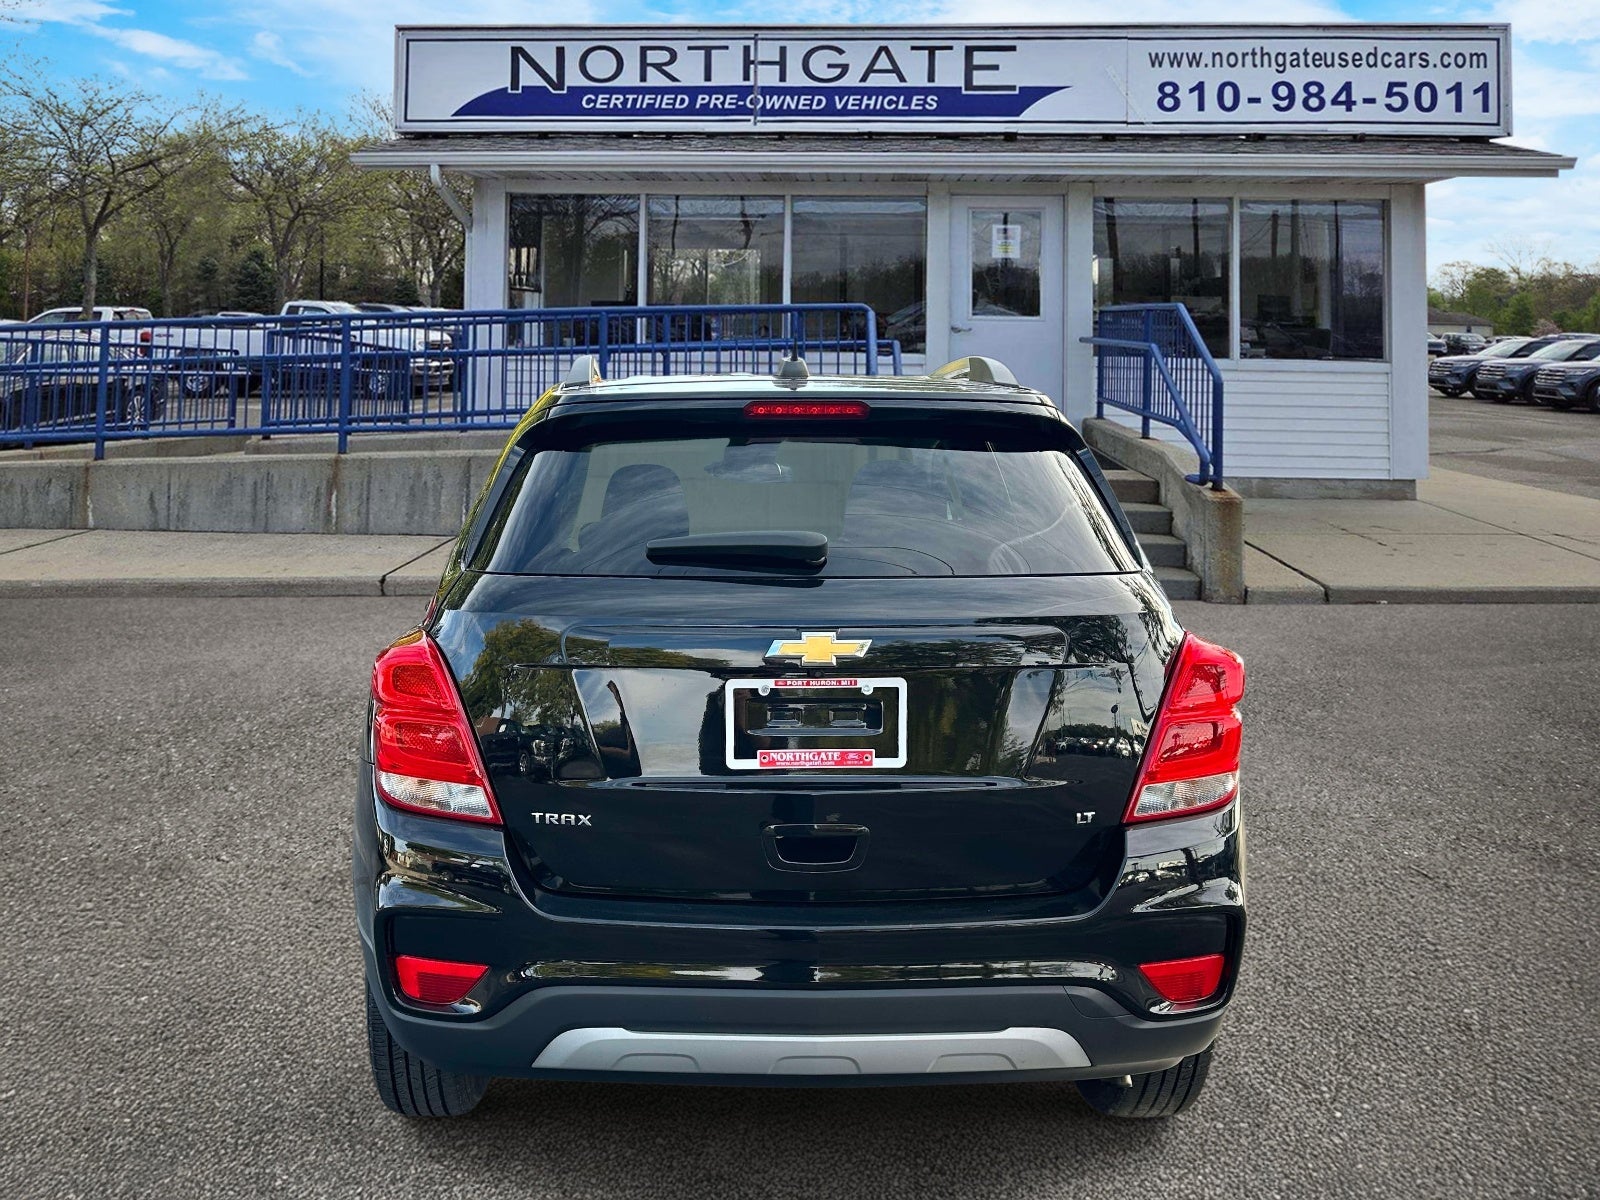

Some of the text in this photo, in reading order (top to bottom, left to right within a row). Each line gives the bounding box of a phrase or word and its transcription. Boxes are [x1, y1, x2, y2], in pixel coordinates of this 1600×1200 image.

[509, 44, 1017, 93] NORTHGATE
[1149, 46, 1488, 73] www.northgateusedcars.com
[581, 93, 938, 111] CERTIFIED PRE-OWNED VEHICLES
[1156, 80, 1491, 114] 810-984-5011
[769, 752, 841, 761] NORTHGATE
[531, 812, 592, 827] TRAX
[1076, 811, 1096, 824] LT
